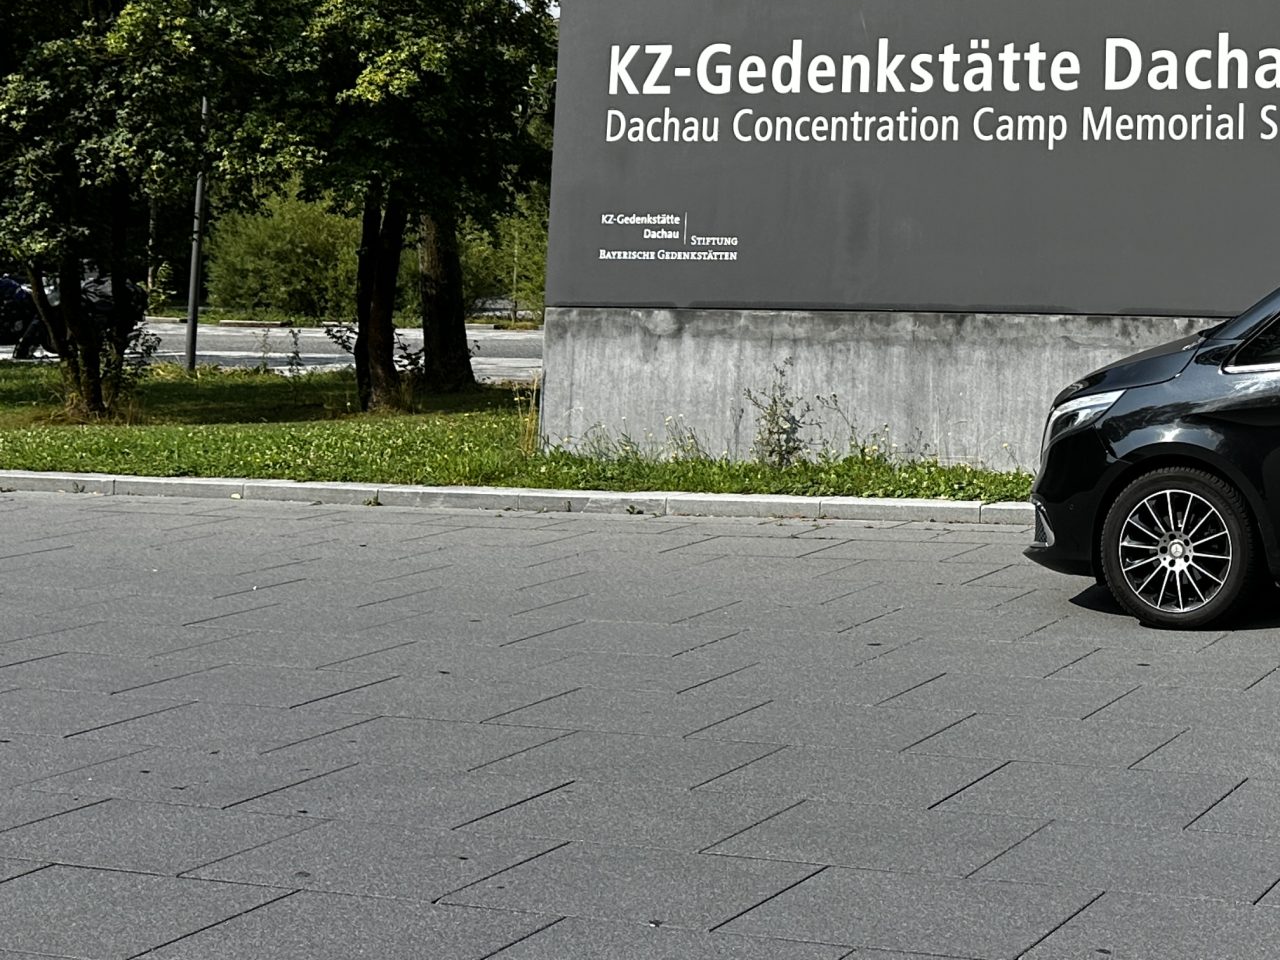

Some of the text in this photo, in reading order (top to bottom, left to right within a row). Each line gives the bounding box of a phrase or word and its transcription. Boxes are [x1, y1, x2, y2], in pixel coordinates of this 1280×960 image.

[607, 37, 1082, 95] KZ-Gedenkstätte
[604, 106, 721, 143] Dachau
[732, 106, 960, 143] Concentration
[972, 106, 1068, 151] Camp
[1081, 102, 1246, 142] Memorial
[601, 213, 681, 225] KZ-Gedenkstätte
[643, 228, 680, 239] Dachau
[690, 235, 739, 246] STIFTUNG
[598, 249, 738, 261] BAYERISCHE GEDENKSTÄTTEN
